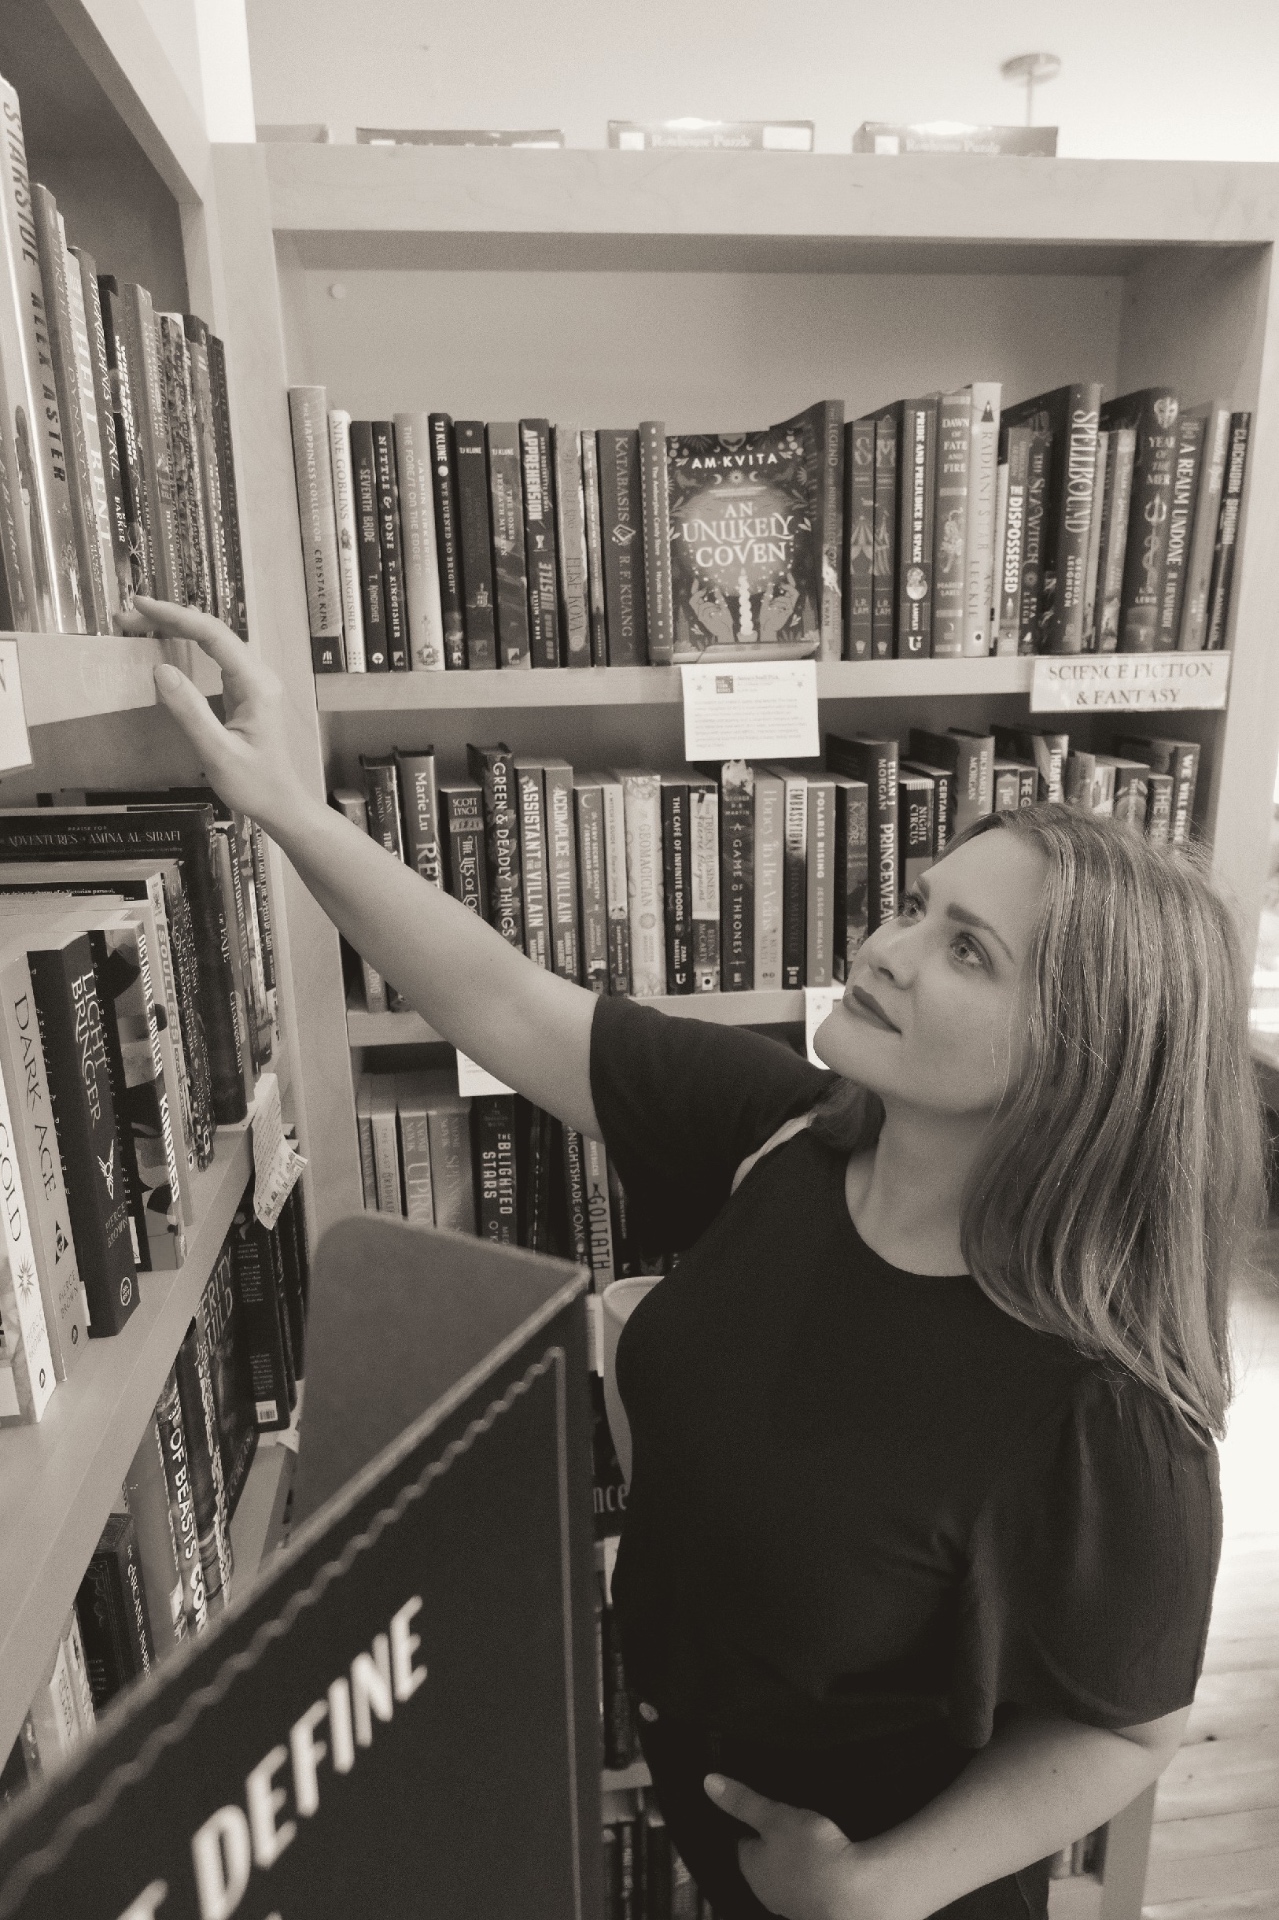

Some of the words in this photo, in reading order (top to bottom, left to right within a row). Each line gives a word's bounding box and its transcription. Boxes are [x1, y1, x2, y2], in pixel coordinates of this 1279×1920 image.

[4, 102, 38, 266] STARSIDE
[31, 292, 50, 364] ALEX
[43, 384, 66, 482] ASTER
[333, 420, 344, 454] NINE
[434, 420, 445, 431] TJ
[828, 423, 839, 467] LEGEND
[914, 411, 926, 438] PRIDE
[942, 417, 970, 429] DAWN
[1148, 437, 1175, 449] YEAR
[305, 419, 317, 480] HAPPINESS
[404, 446, 415, 489] FOREST
[436, 432, 448, 463] KLUNE
[722, 452, 779, 468] KVITA
[915, 440, 925, 459] AND
[943, 441, 969, 452] FATE
[943, 463, 967, 474] FIRE
[979, 430, 995, 503] RADIANT
[1032, 452, 1044, 475] THE
[1228, 428, 1247, 494] CLOCKWORK
[336, 457, 350, 520] GOBLINS
[360, 468, 374, 512] SEVENTH
[378, 435, 391, 491] NETTLE
[385, 514, 395, 550] BONE
[441, 481, 449, 497] WE
[524, 430, 543, 522] APPREHENSION
[615, 436, 630, 523] KATABASIS
[914, 460, 925, 514] PREJUDICE
[1065, 409, 1099, 534] SPELLBOUND
[1175, 458, 1194, 505] REALM
[115, 496, 126, 543] BARKER
[309, 480, 322, 543] COLLECTOR
[363, 514, 376, 544] BRIDE
[442, 500, 453, 538] BURNED
[508, 510, 516, 541] BONES
[682, 512, 795, 544] UNLIKELY
[723, 501, 754, 519] AN
[976, 508, 992, 552] STAR
[447, 540, 454, 555] SO
[695, 539, 788, 568] COVEN
[912, 531, 923, 564] SPACE
[1004, 497, 1022, 593] DISPOSSESSED
[1025, 508, 1044, 566] WITCH
[1166, 508, 1189, 567] UNDONE
[315, 549, 325, 597] CRYSTAL
[320, 600, 329, 631] KING
[447, 557, 457, 595] BRIGHT
[538, 561, 555, 611] HUSTLE
[968, 560, 981, 618] LECKIE
[1063, 555, 1074, 608] LEIGHTON
[1072, 556, 1083, 606] GEORGIA
[345, 567, 357, 632] KINGFISHER
[370, 584, 381, 624] KINGFISHER
[390, 575, 401, 639] KINGFISHER
[621, 583, 634, 638] KUANG
[1028, 597, 1038, 619] EVA
[1048, 664, 1128, 681] SCIENCE
[1132, 660, 1213, 681] FICTION
[1076, 690, 1088, 705] &
[1093, 687, 1180, 705] FANTASY
[492, 762, 508, 810] GREEN
[878, 758, 887, 811] MORGAN
[887, 760, 896, 797] ELIAN
[1049, 754, 1062, 782] HEAR
[1181, 754, 1194, 778] WE
[414, 771, 427, 812] Marie
[452, 798, 477, 807] SCOTT
[454, 807, 477, 815] LYNCH
[672, 796, 681, 808] THE
[762, 789, 778, 838] Honey
[939, 778, 948, 822] CERTAIN
[1153, 787, 1172, 815] THE
[1177, 781, 1190, 808] WILL
[419, 813, 431, 831] Lu
[496, 813, 504, 825] &
[519, 775, 542, 858] ASSISTANT
[552, 786, 570, 857] ACCOMPLICE
[672, 809, 682, 837] CAFÉ
[706, 814, 715, 851] TRICKY
[788, 788, 805, 852] EMBASSYTOWN
[816, 791, 825, 838] POLARIS
[909, 803, 918, 845] CIRCUS
[918, 805, 928, 842] NIGHT
[7, 835, 79, 849] ADVENTURES
[88, 831, 124, 843] AMINA
[126, 830, 181, 843] AL-SIRAFI
[230, 836, 238, 856] THE
[496, 829, 512, 882] DEADLY
[732, 839, 743, 877] GAME
[816, 841, 825, 880] RISING
[459, 856, 476, 878] LIES
[639, 824, 654, 906] GEOMAGICIAN
[674, 849, 683, 889] INFINITE
[706, 854, 716, 900] BUSINESS
[762, 862, 777, 889] Her
[232, 859, 245, 924] PHOTONIC
[500, 886, 515, 937] THINGS
[526, 871, 544, 928] VILLAIN
[557, 871, 573, 923] VILLAIN
[675, 890, 684, 922] DOORS
[762, 890, 778, 931] Veins
[220, 926, 230, 963] FATE
[732, 896, 744, 954] THRONES
[157, 924, 180, 1041] SOULLESS
[83, 968, 108, 1070] LIGHT
[137, 933, 154, 1000] OCTAVIA
[148, 1015, 164, 1080] BUTLER
[71, 976, 101, 1129] BRINGER
[14, 994, 42, 1112] DARK
[34, 1124, 57, 1201] AGE
[159, 1092, 181, 1202] KINDRED
[568, 1130, 583, 1205] NIGHTSHADE
[482, 1151, 497, 1200] STARS
[497, 1142, 513, 1214] BLIGHTED
[104, 1200, 126, 1235] PIERCE
[573, 1215, 585, 1240] OAK
[587, 1193, 612, 1270] GOLIATH
[170, 1426, 186, 1464] OF
[174, 1469, 198, 1560] BEASTS
[593, 1483, 628, 1514] nce
[192, 1595, 428, 1920] DEFINE
